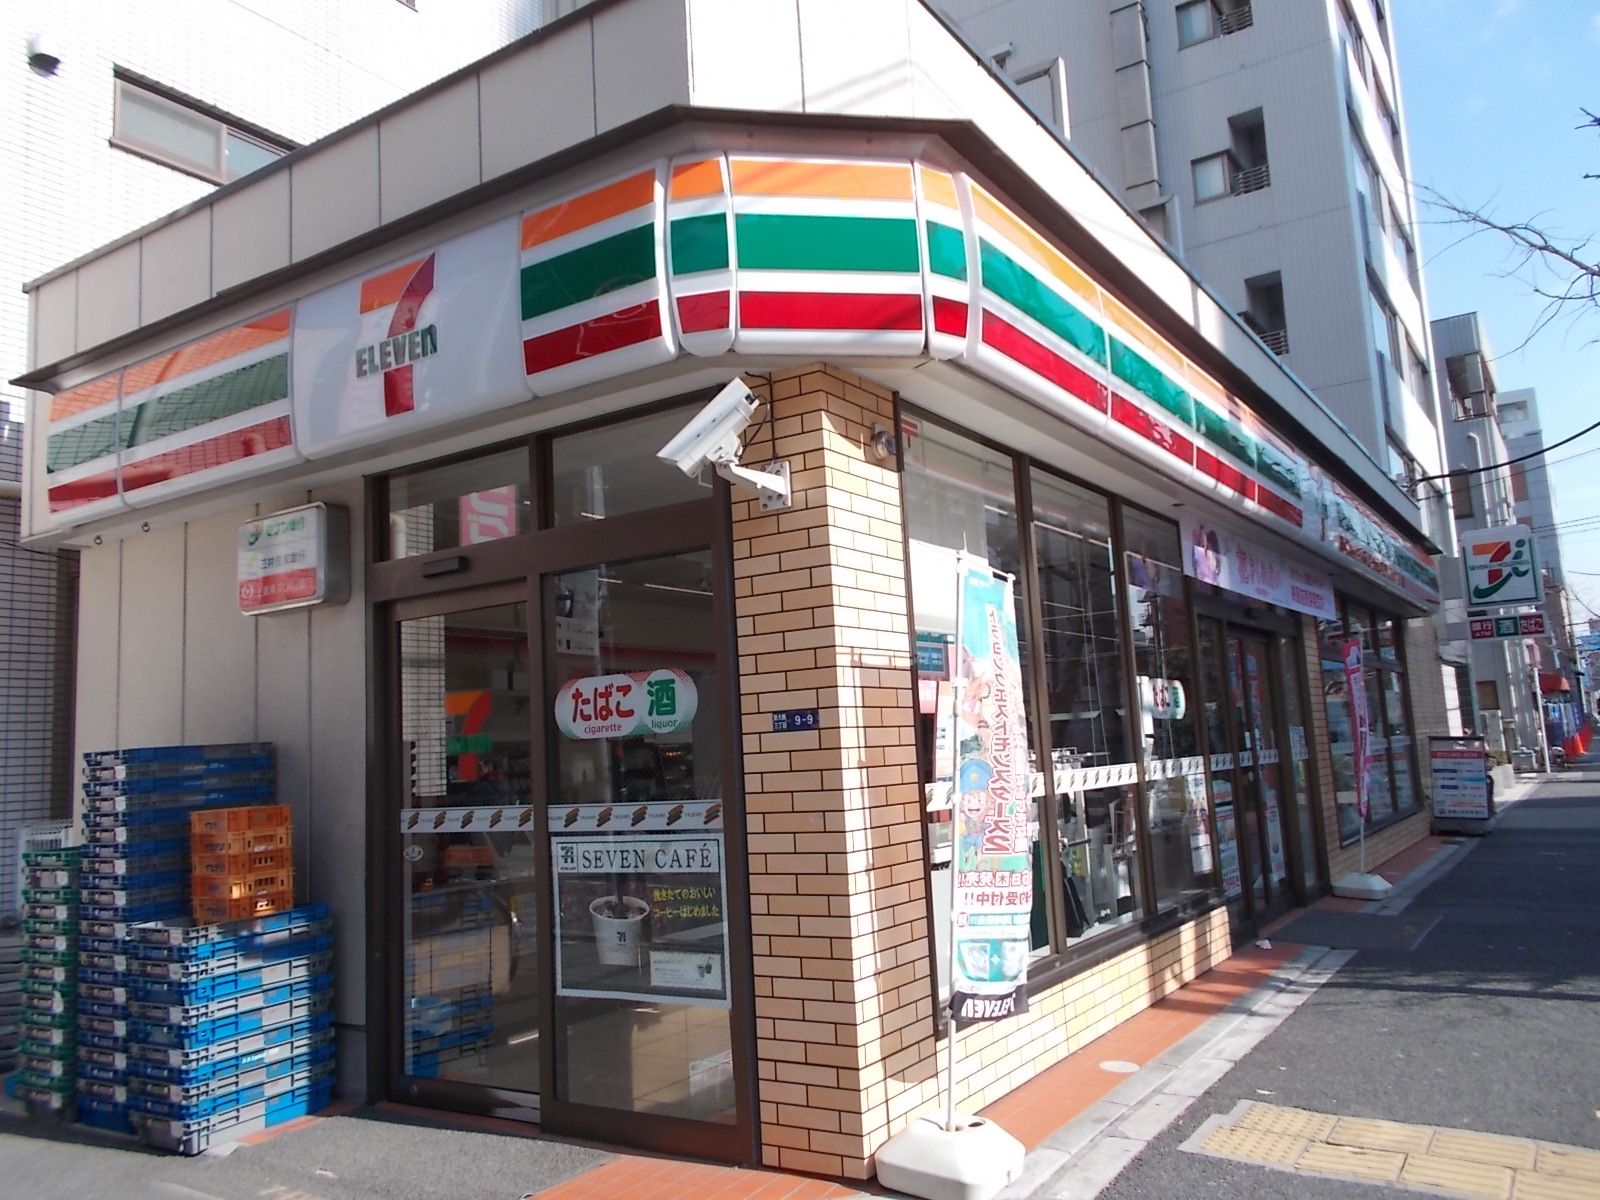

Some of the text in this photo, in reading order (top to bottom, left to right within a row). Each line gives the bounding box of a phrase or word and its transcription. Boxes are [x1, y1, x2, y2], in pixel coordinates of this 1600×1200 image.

[360, 252, 435, 417] 7
[572, 678, 676, 723] たばこ 酒
[584, 719, 678, 736] cigarette liquor
[794, 713, 814, 726] 9-9
[582, 842, 712, 869] SEVEN CAFÉ
[652, 904, 720, 919] コーヒーはじめました
